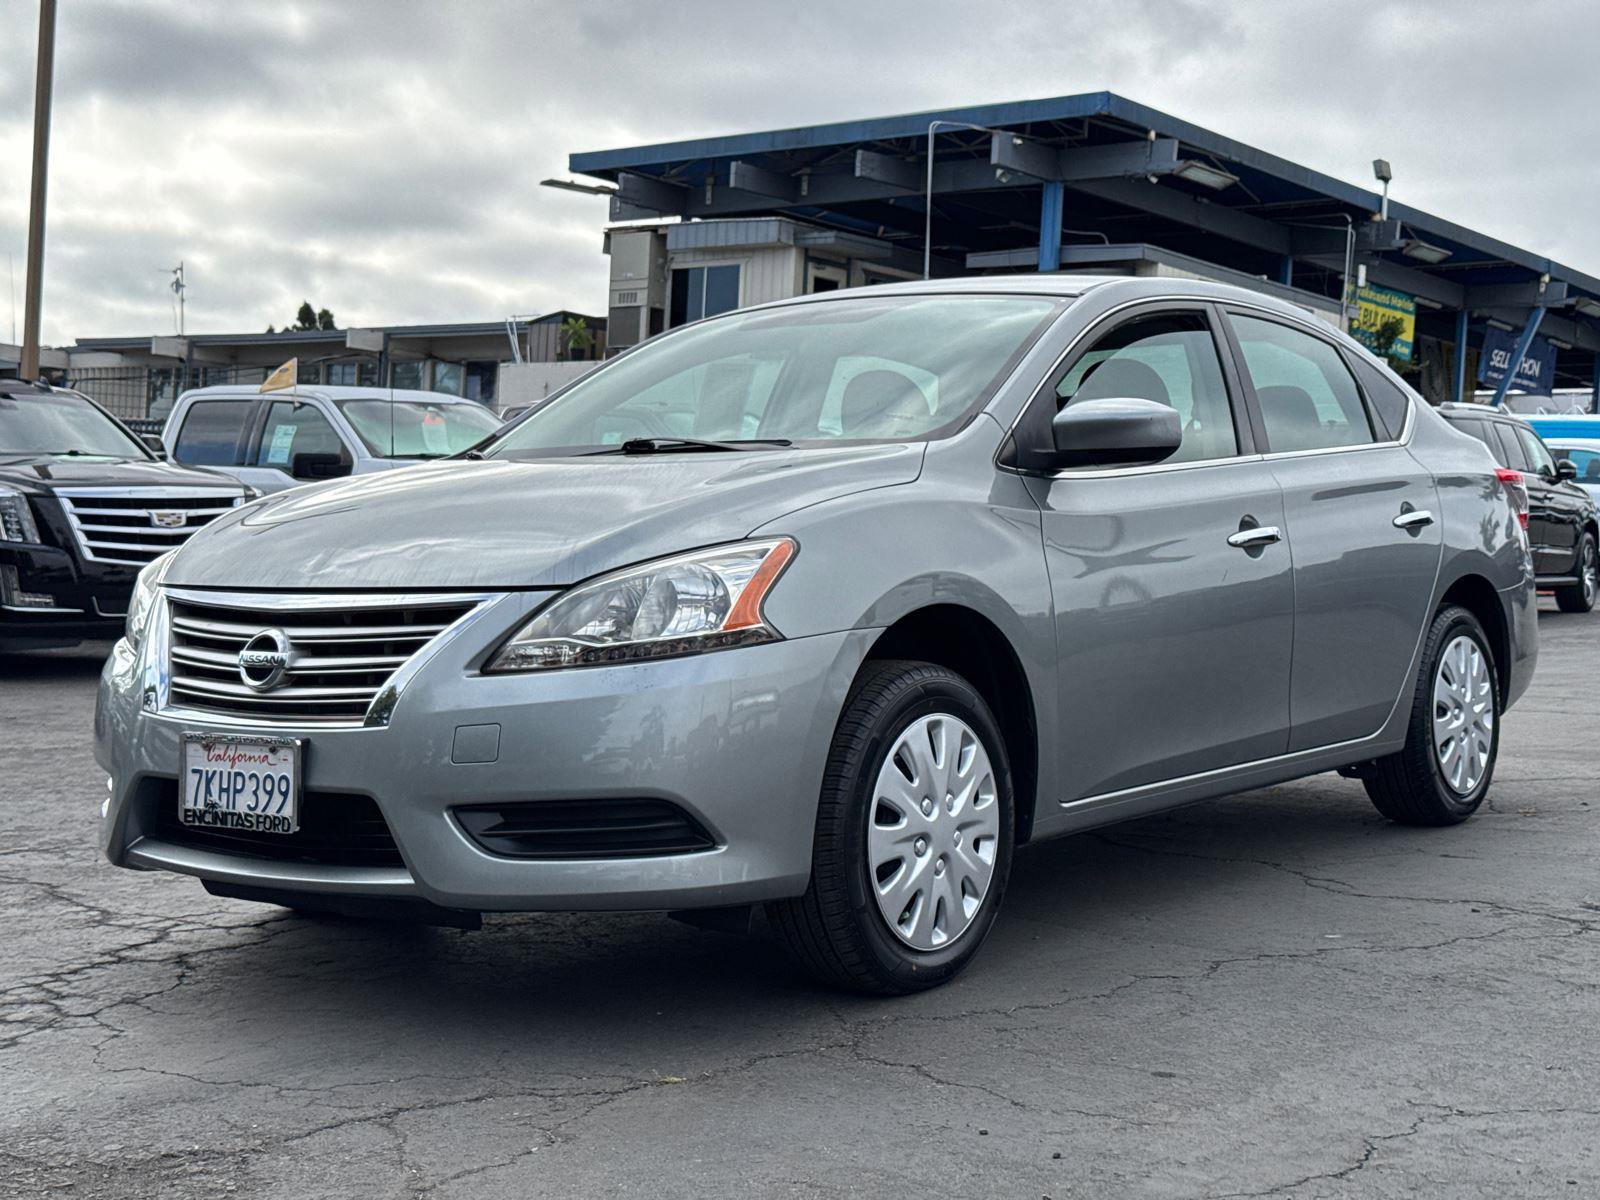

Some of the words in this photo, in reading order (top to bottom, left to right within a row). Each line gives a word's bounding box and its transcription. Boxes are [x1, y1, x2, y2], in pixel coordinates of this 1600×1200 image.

[240, 654, 280, 666] NISSAN
[206, 742, 277, 769] California
[191, 768, 291, 814] 7KHP399
[183, 807, 255, 829] ENCINITAS
[255, 814, 291, 833] FORD
